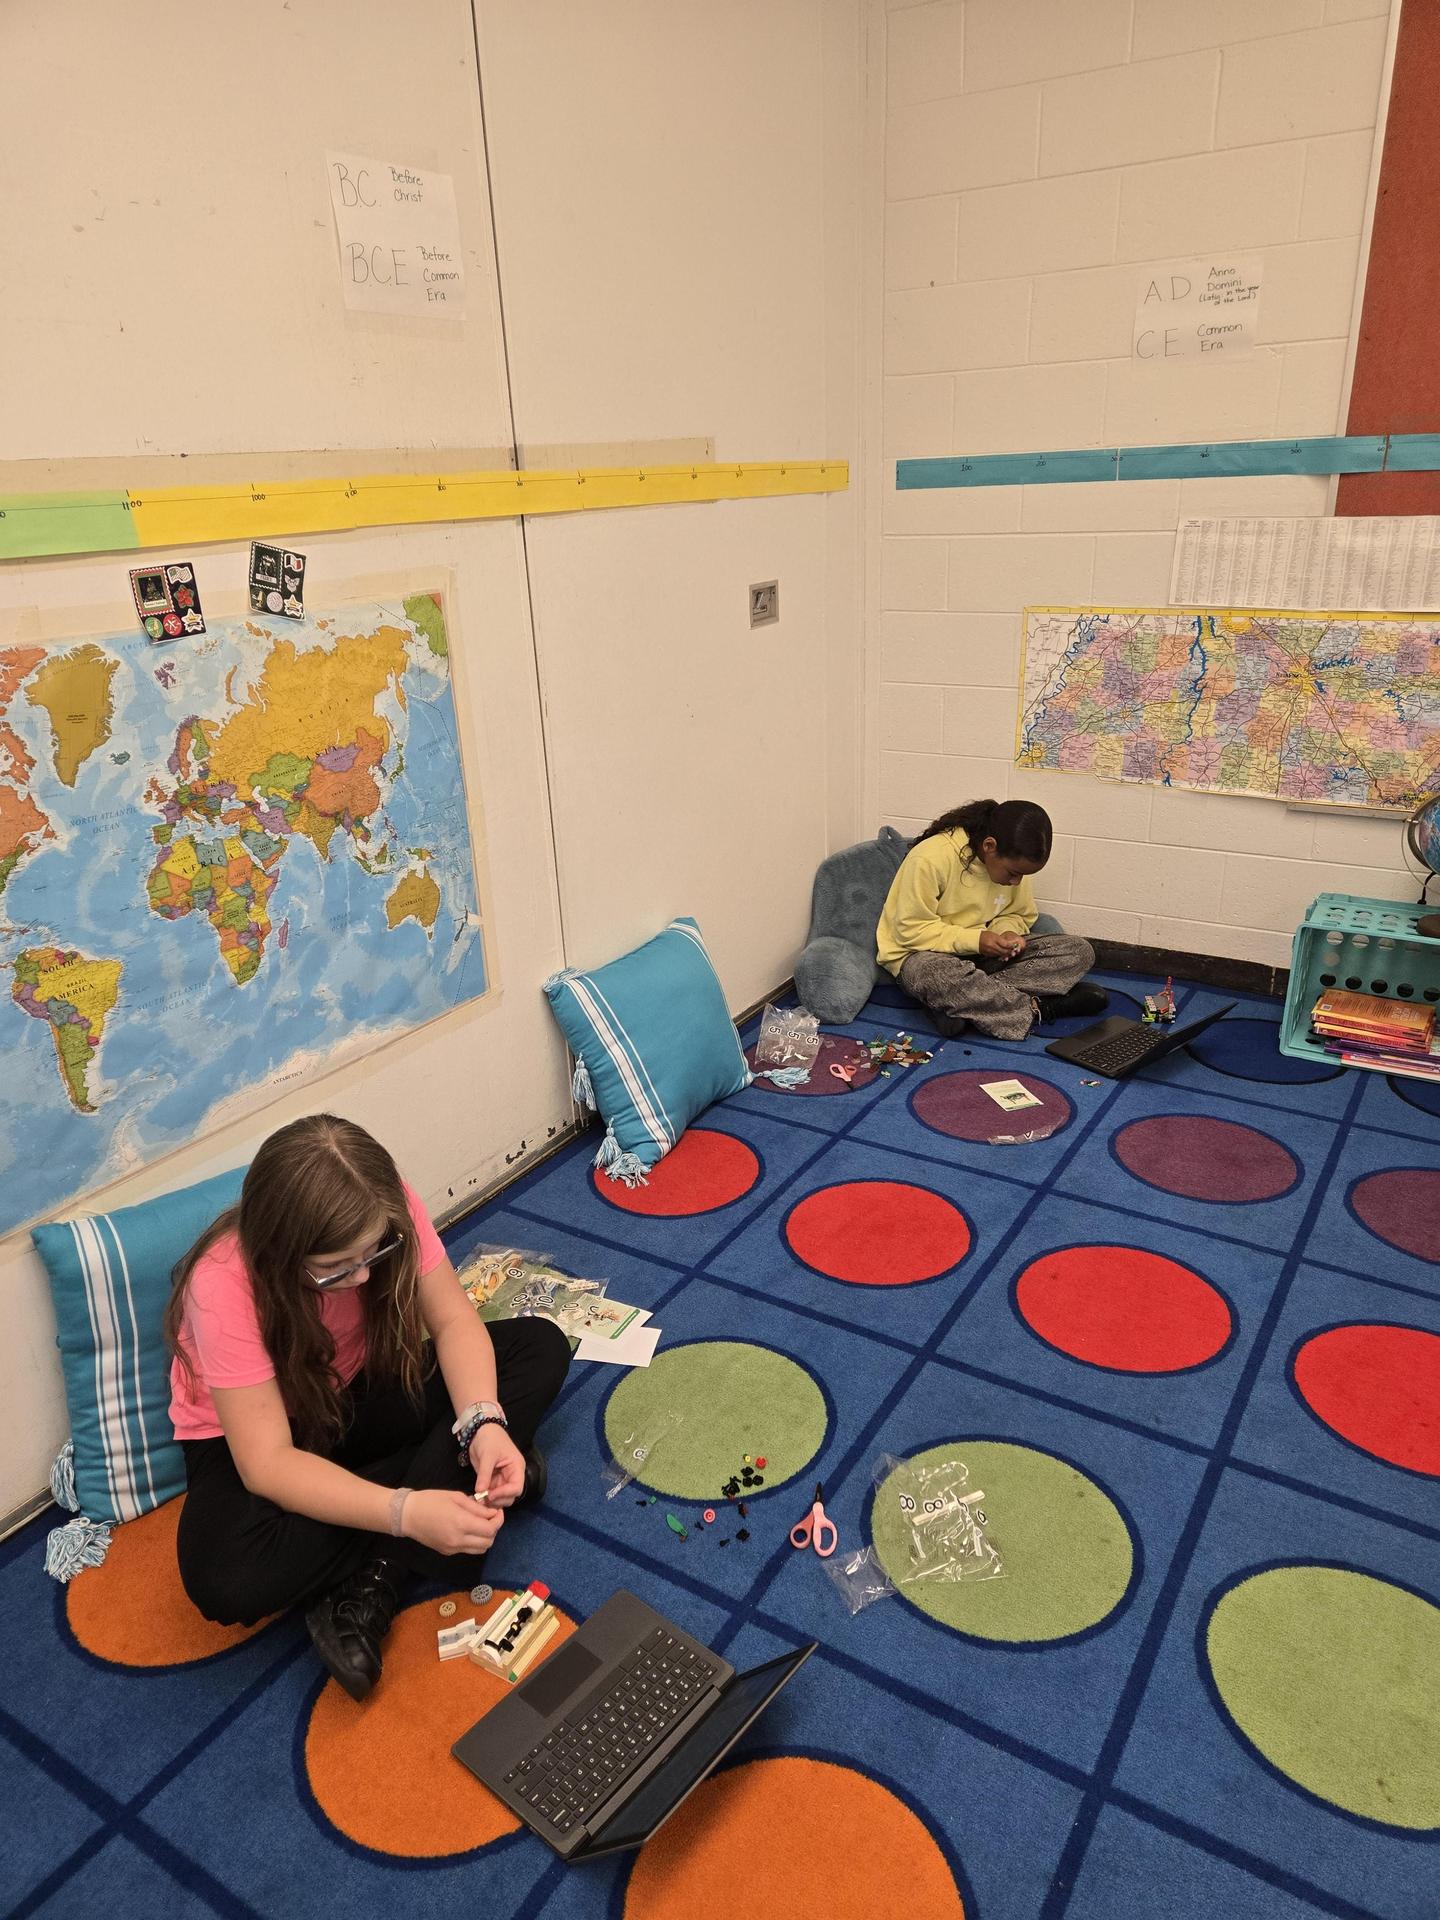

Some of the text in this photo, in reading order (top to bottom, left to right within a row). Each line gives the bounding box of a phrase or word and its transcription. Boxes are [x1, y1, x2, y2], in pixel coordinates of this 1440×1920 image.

[388, 166, 423, 186] Before
[394, 189, 423, 202] Christ
[416, 246, 452, 262] Before
[423, 268, 460, 283] Common
[1208, 267, 1236, 279] Anno
[1207, 279, 1242, 292] Domini
[427, 288, 447, 301] Era
[1197, 323, 1243, 337] Common
[1201, 340, 1224, 352] Era
[961, 464, 973, 472] 100
[121, 500, 142, 511] 1100
[251, 493, 266, 502] 1000
[344, 489, 357, 498] 900
[43, 960, 75, 974] SOUTH
[536, 1295, 554, 1307] 10
